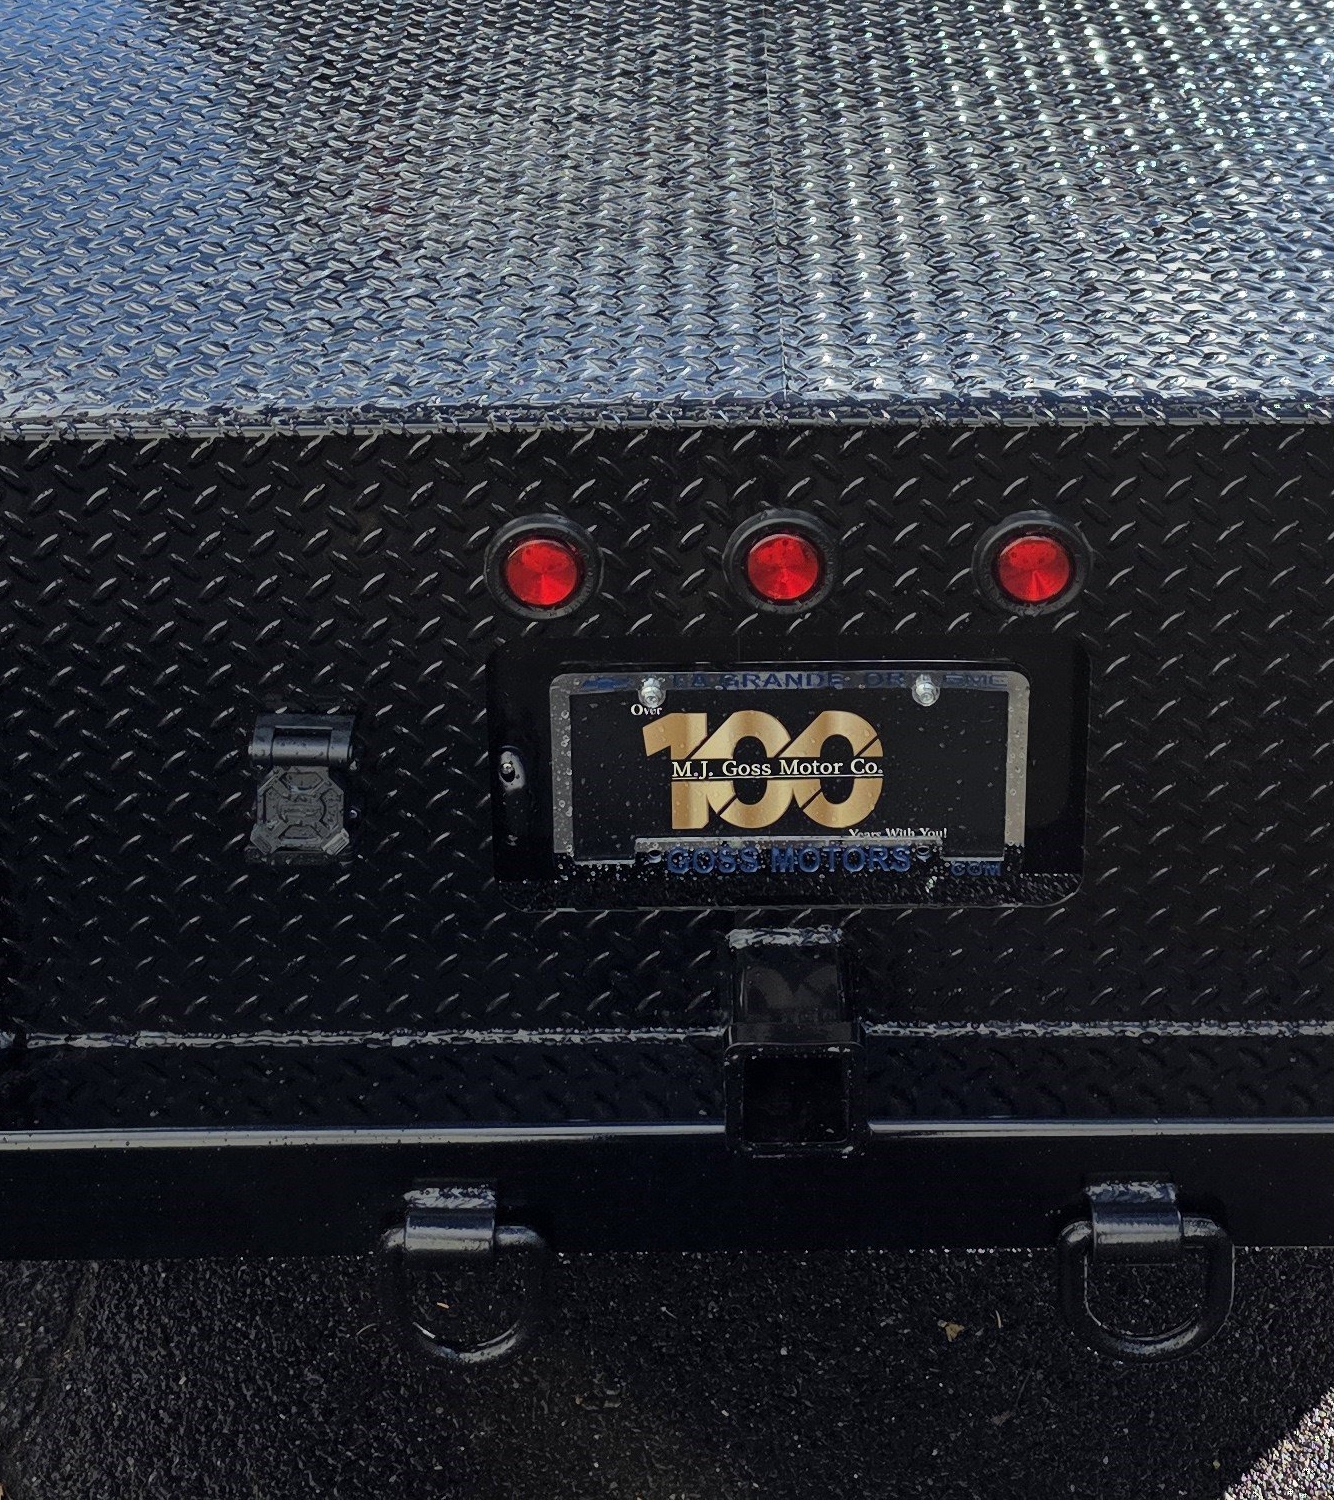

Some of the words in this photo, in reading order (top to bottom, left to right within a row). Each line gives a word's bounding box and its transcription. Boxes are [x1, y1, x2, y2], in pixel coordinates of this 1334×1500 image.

[720, 671, 844, 689] GRANDE
[630, 703, 663, 717] Over
[642, 709, 884, 830] 100
[671, 761, 714, 780] M.J.
[722, 760, 772, 776] Goss
[779, 758, 844, 776] Motor
[850, 758, 884, 774] Co.
[848, 828, 882, 838] Years
[885, 827, 915, 837] With
[919, 827, 948, 839] You!
[666, 845, 760, 874] GOSS
[770, 844, 912, 873] MOTORS
